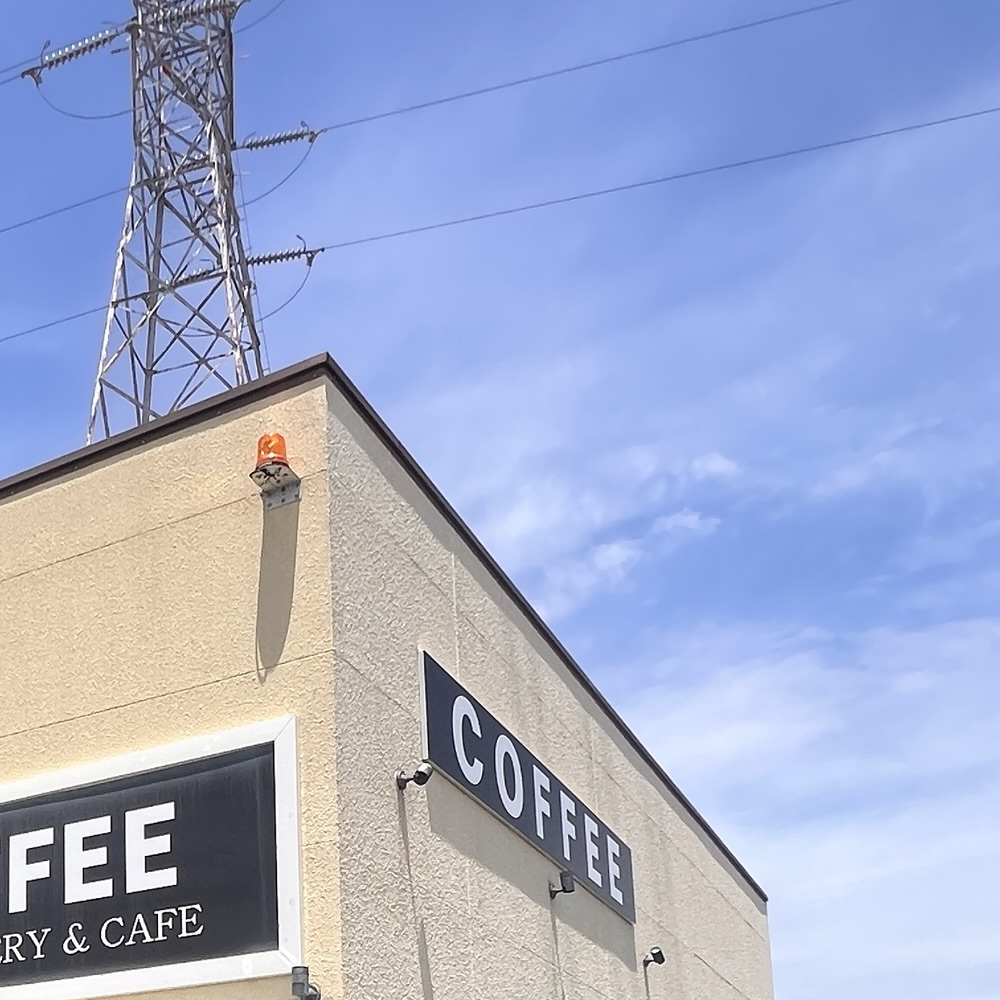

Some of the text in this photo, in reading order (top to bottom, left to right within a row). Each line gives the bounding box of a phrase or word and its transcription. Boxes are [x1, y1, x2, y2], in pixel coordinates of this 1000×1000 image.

[452, 695, 624, 906] COFFEE
[62, 922, 91, 955] &
[100, 903, 204, 948] CAFE
